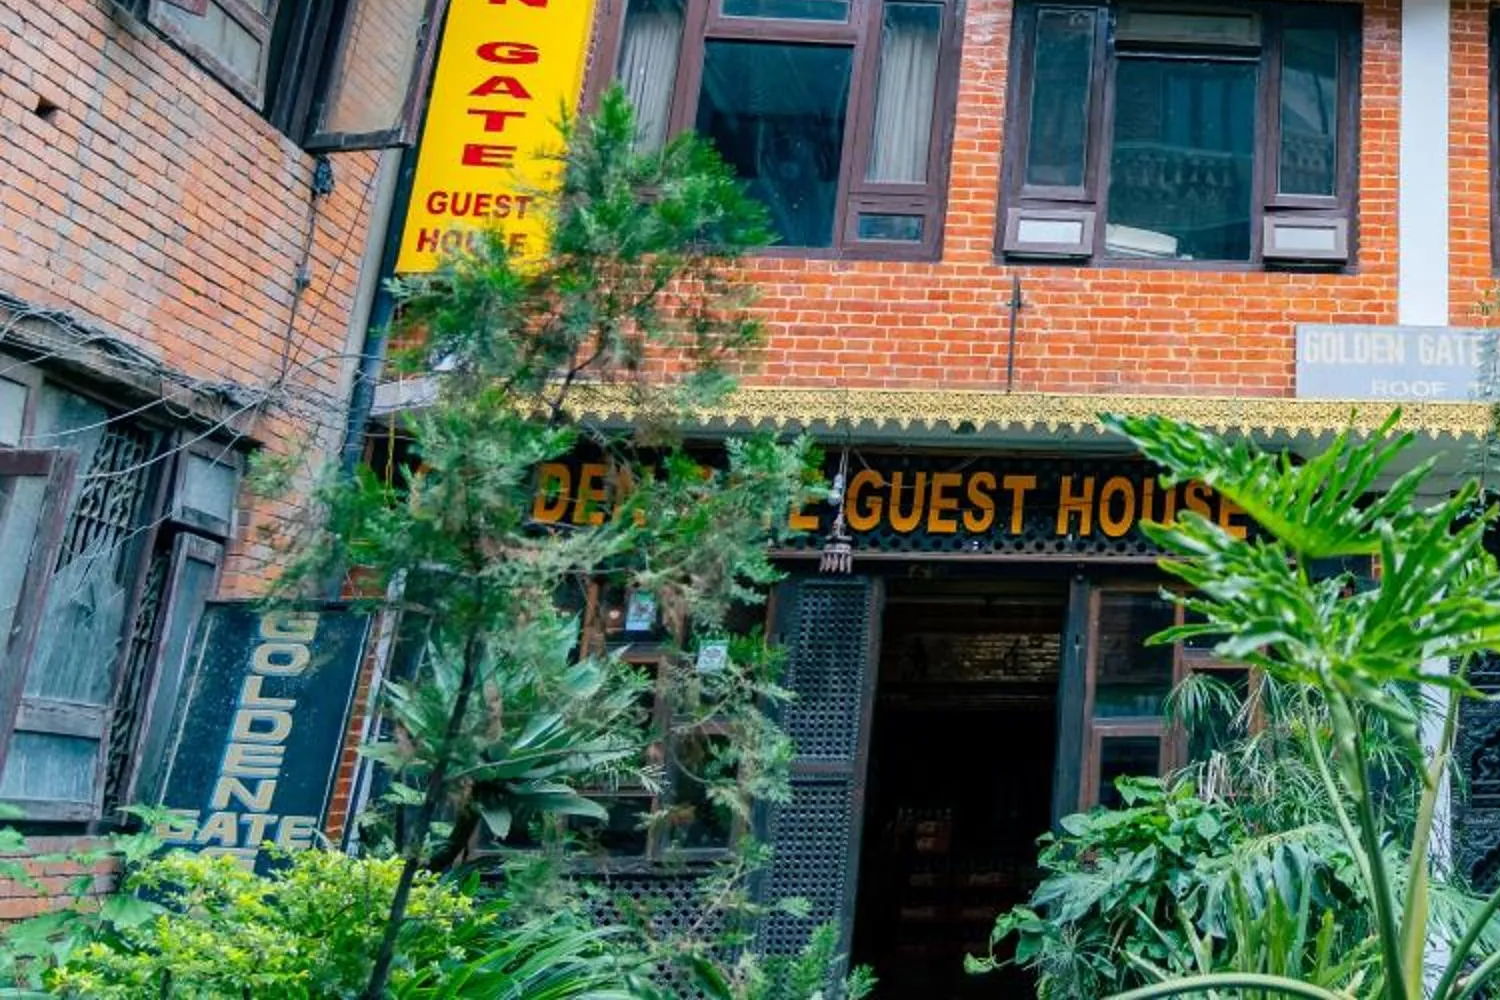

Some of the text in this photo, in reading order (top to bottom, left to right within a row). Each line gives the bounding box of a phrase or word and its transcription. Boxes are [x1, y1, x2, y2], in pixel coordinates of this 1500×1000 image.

[461, 41, 540, 169] GATE
[426, 190, 534, 220] GUEST
[416, 227, 528, 258] HOE
[1303, 330, 1407, 366] GOLDEN
[1369, 378, 1449, 398] ROOF
[846, 469, 1036, 535] GUEST
[1055, 473, 1248, 540] HOUSE
[209, 610, 320, 812] GOLDEN
[156, 808, 318, 850] GATE
